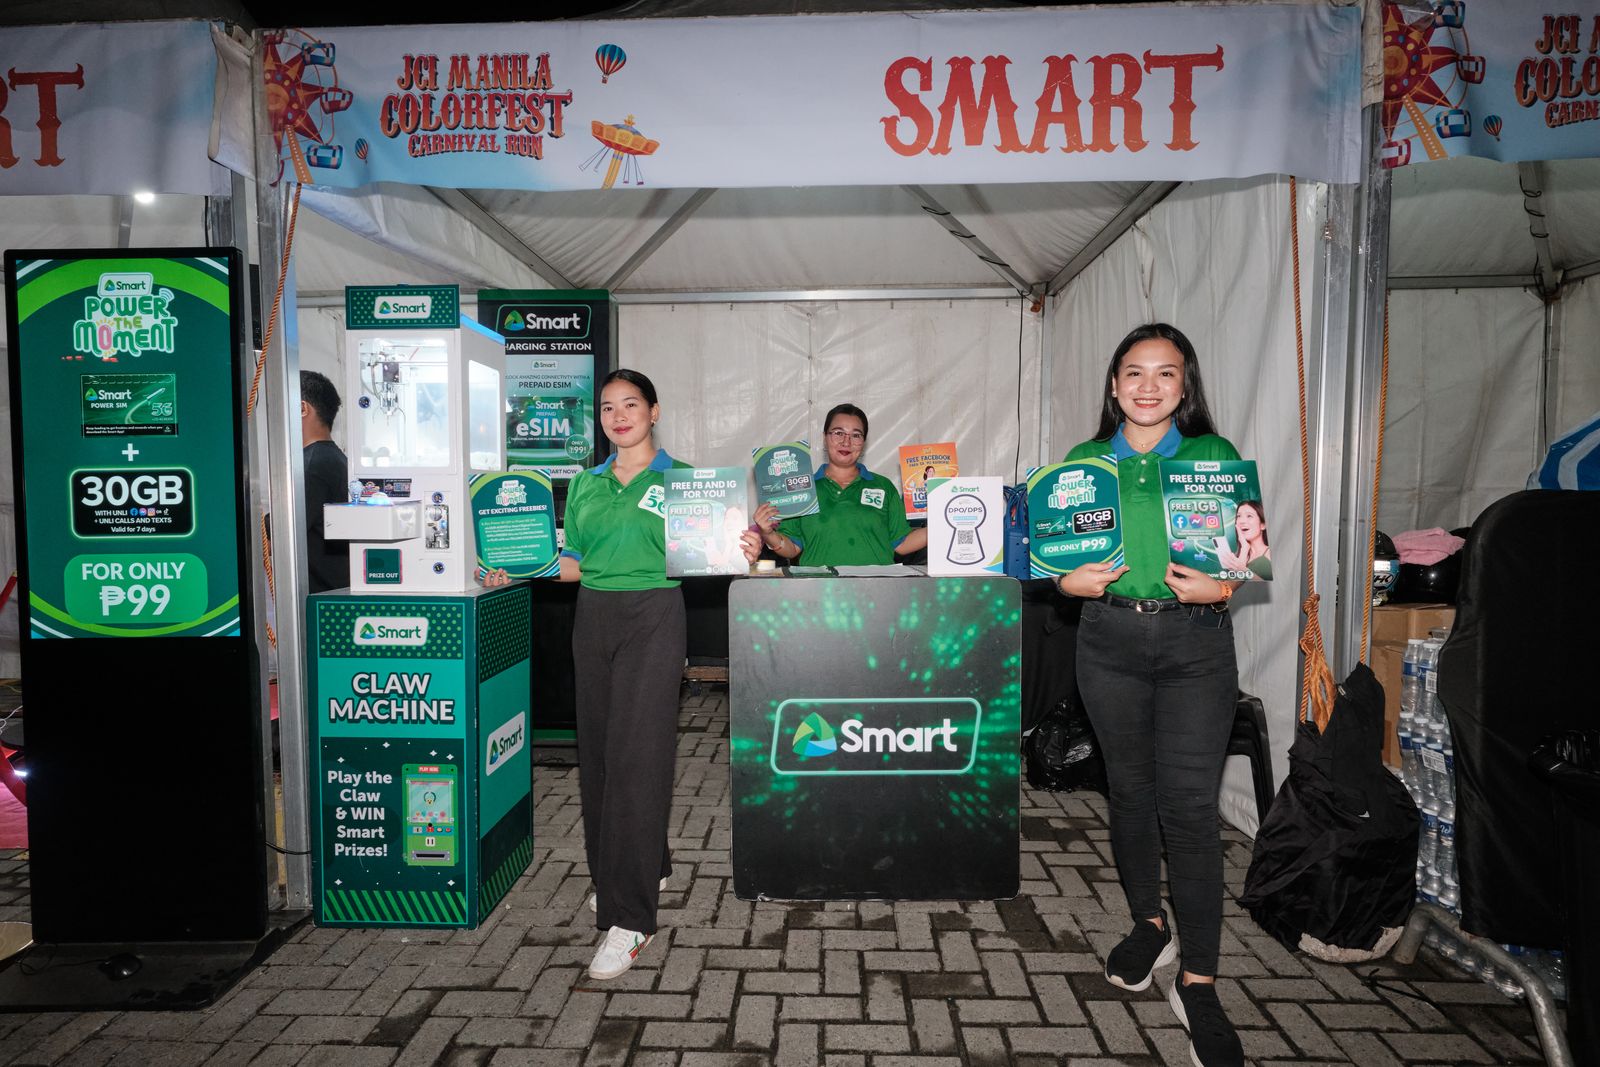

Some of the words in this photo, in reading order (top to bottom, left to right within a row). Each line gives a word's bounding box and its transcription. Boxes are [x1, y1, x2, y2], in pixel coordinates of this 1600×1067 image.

[1535, 14, 1581, 54] JCI
[397, 53, 439, 91] JCI
[447, 52, 555, 91] MANILA
[879, 44, 1224, 156] SMART
[380, 89, 573, 138] COLORFEST
[408, 134, 500, 158] CARNIVAL
[505, 134, 544, 160] RUN
[116, 280, 146, 291] Smart
[85, 296, 170, 320] POWER
[392, 302, 427, 314] Smart
[526, 313, 581, 330] Smart
[505, 342, 546, 351] HARGING
[550, 342, 592, 351] STATION
[98, 389, 132, 400] Smart
[151, 402, 173, 416] 5G
[536, 400, 564, 410] Smart
[516, 418, 570, 437] eSIM
[672, 482, 691, 490] FREE
[705, 481, 725, 489] AND
[727, 480, 736, 488] IG
[787, 476, 809, 486] 30GB
[1170, 474, 1192, 483] FREE
[1194, 474, 1207, 483] FB
[1208, 474, 1234, 483] AND
[1235, 474, 1246, 483] IG
[80, 475, 184, 506] 30GB
[1054, 480, 1092, 493] POWER
[1184, 485, 1205, 493] FOR
[1207, 484, 1234, 493] YOU!
[865, 495, 882, 506] 5G
[1171, 502, 1192, 511] FREE
[1193, 501, 1217, 512] 1GB
[689, 506, 710, 515] 1GB
[1076, 510, 1112, 524] 30GB
[1044, 546, 1059, 554] FOR
[1060, 543, 1079, 551] ONLY
[82, 562, 124, 580] FOR
[128, 562, 186, 580] ONLY
[378, 625, 421, 639] Smart
[352, 673, 431, 695] CLAW
[329, 699, 455, 722] MACHINE
[499, 724, 523, 756] Smart
[840, 718, 958, 752] Smart
[328, 771, 362, 787] Play
[365, 771, 392, 784] the
[340, 788, 380, 802] Claw
[336, 807, 347, 820] &
[350, 808, 385, 820] WIN
[336, 826, 384, 839] Smart
[335, 844, 388, 857] Prizes!
